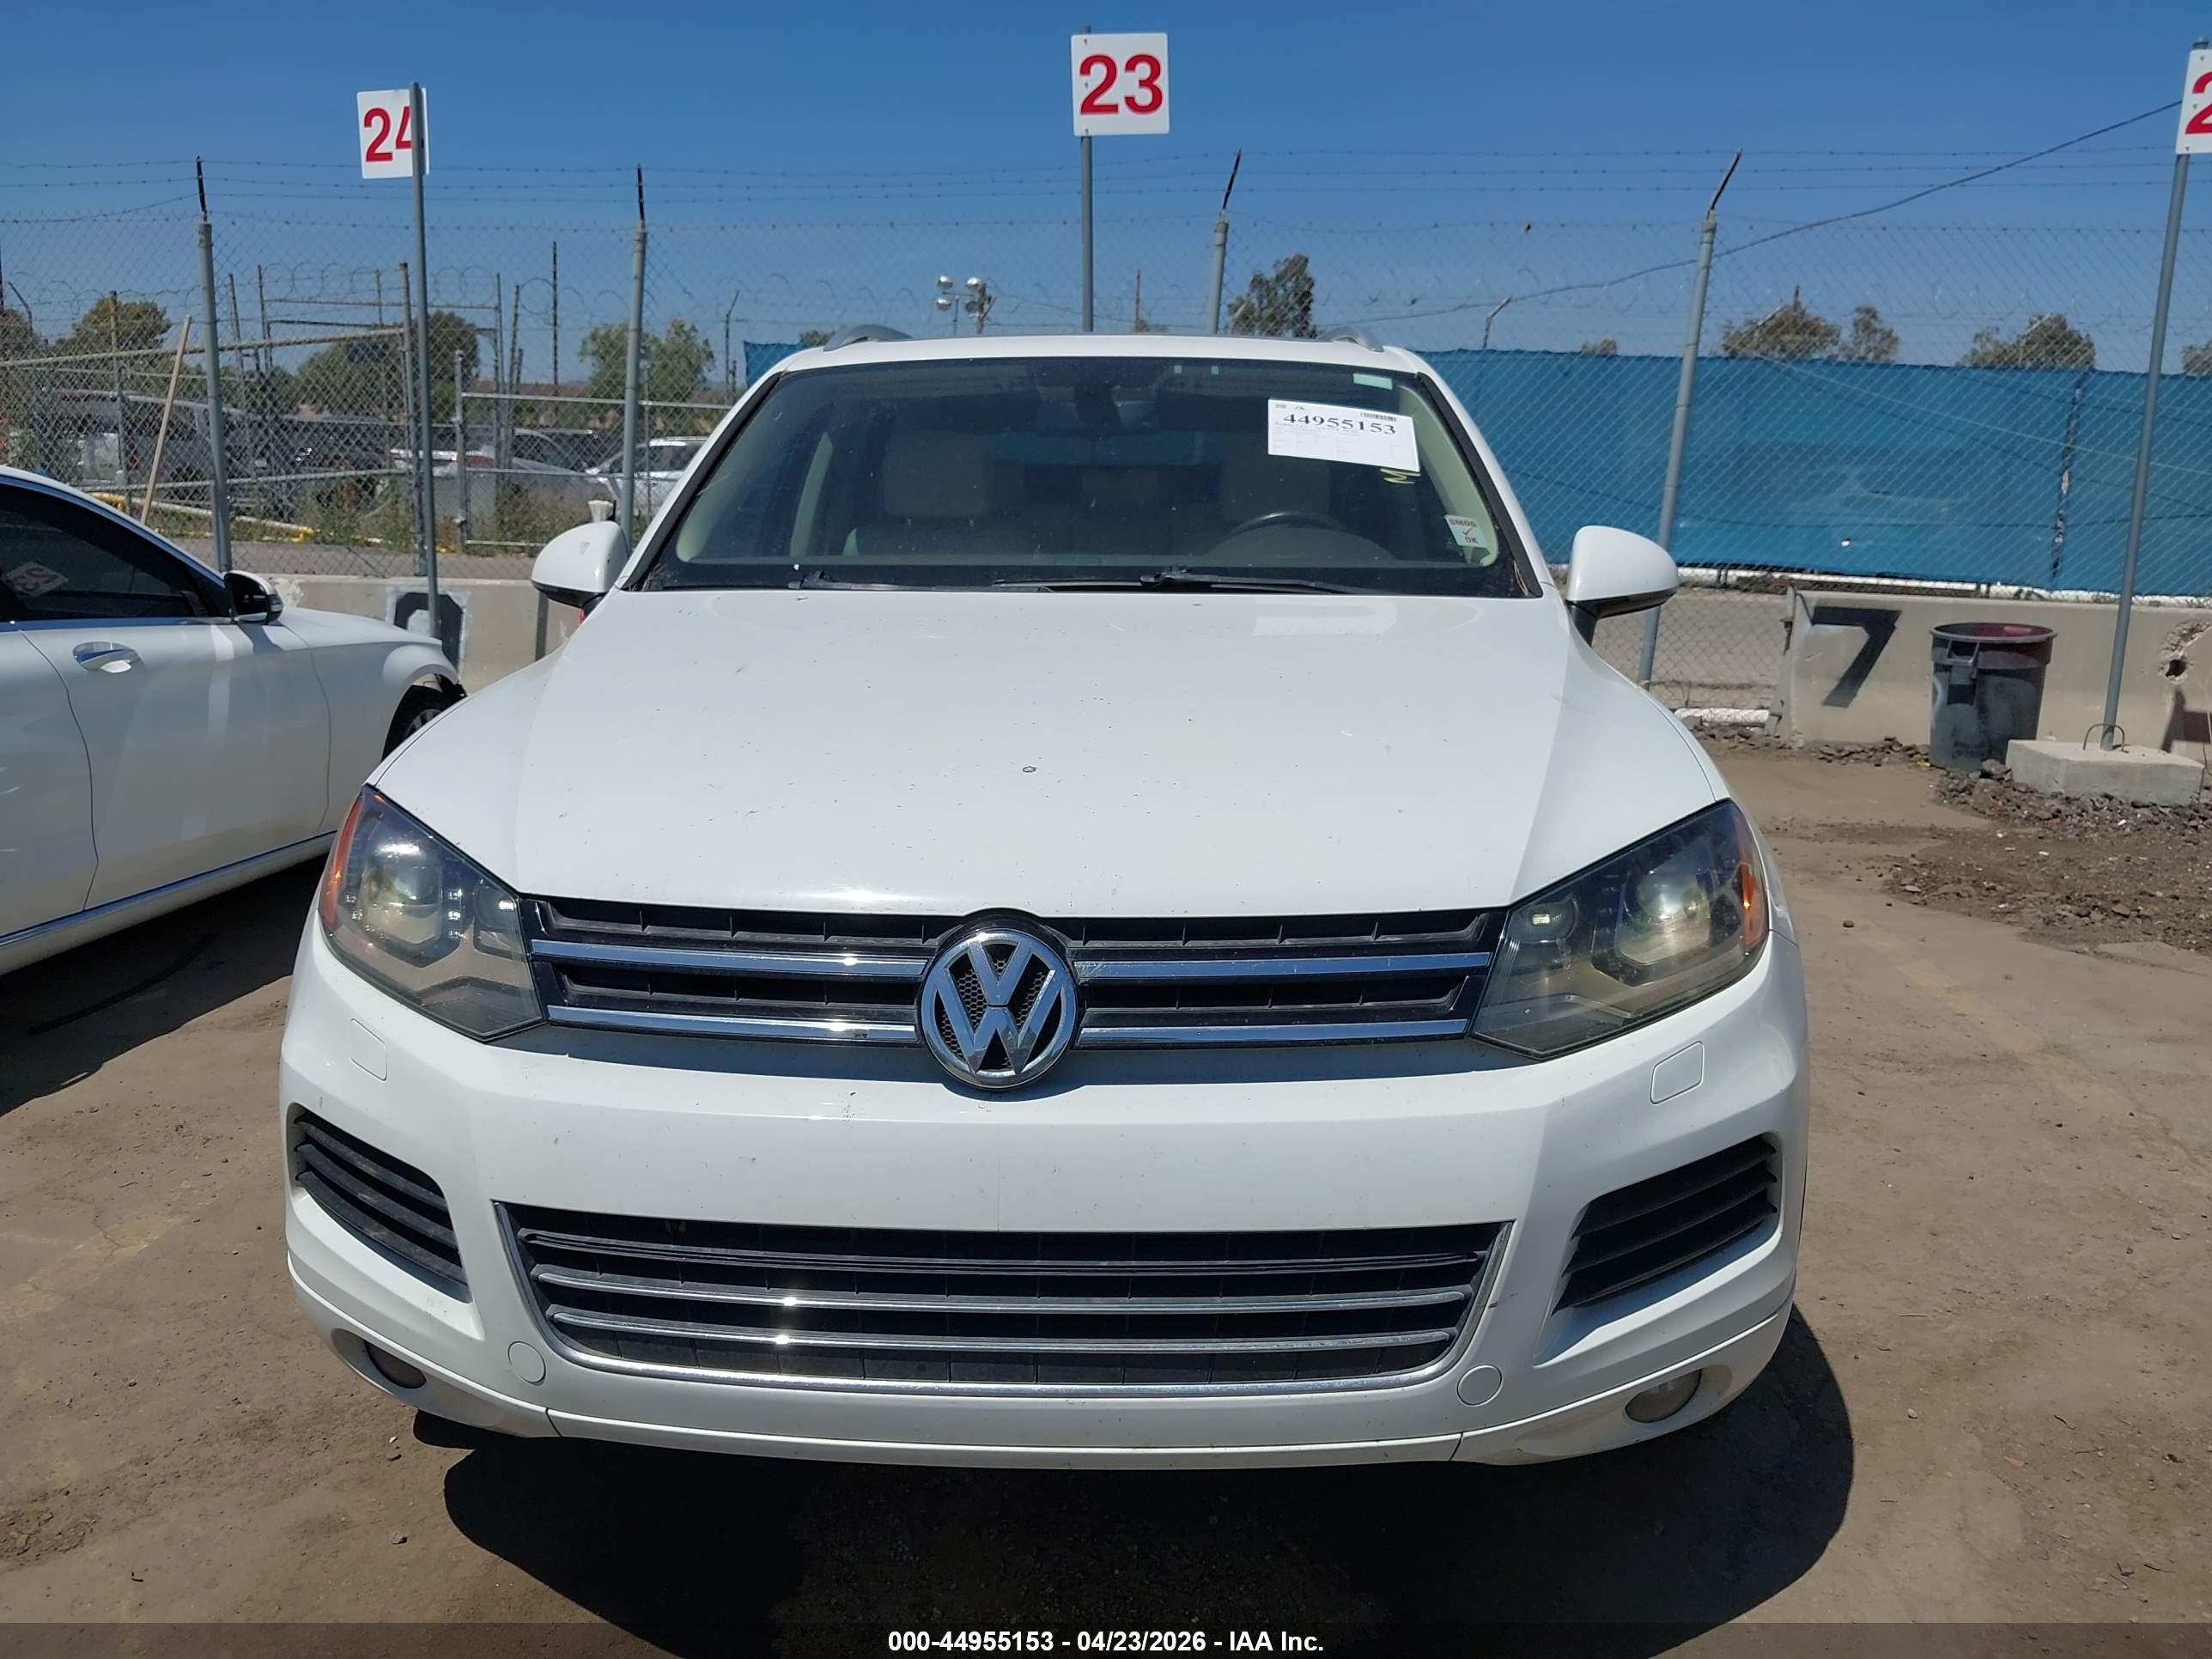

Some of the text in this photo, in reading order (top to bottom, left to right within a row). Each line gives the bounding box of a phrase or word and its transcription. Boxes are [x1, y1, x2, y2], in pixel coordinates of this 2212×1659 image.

[1079, 53, 1164, 116] 23
[363, 105, 413, 163] 24
[1284, 412, 1396, 436] 44955153
[1449, 518, 1478, 528] SMOG
[1464, 536, 1479, 544] OK
[1811, 605, 1902, 708] 7
[929, 934, 1068, 1080] VW
